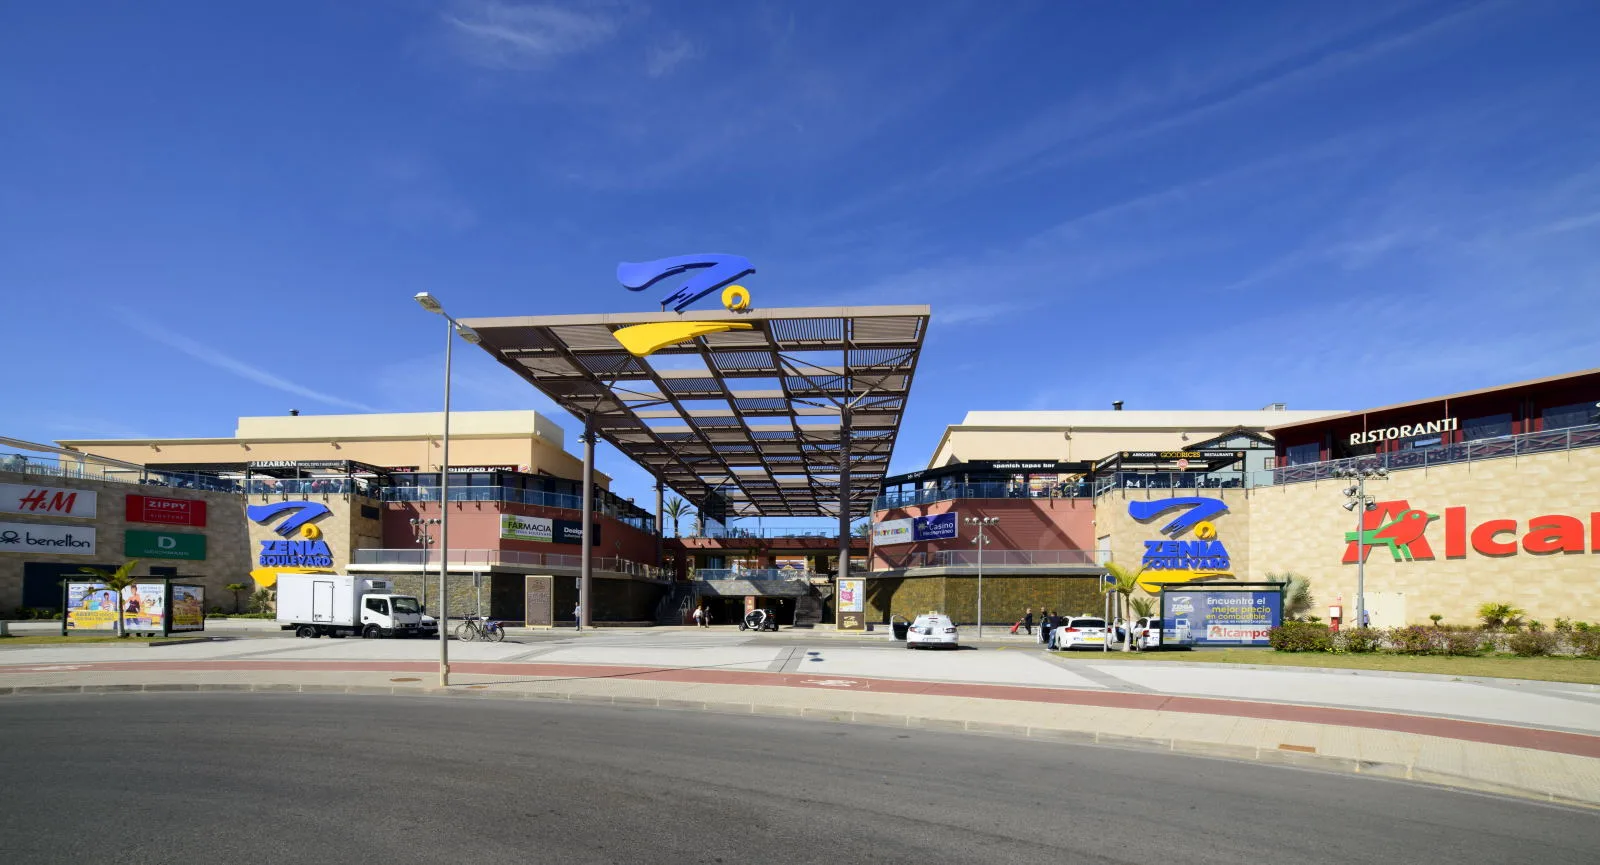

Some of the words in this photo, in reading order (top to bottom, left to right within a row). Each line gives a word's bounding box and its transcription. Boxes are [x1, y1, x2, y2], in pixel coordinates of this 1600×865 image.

[1350, 417, 1457, 446] RISTORANTI
[19, 489, 78, 514] H&M
[149, 501, 186, 510] ZIPPY
[508, 521, 551, 532] FARMACIA
[929, 523, 954, 531] Casino
[1341, 500, 1600, 565] Alca
[26, 531, 91, 548] benetton
[158, 536, 177, 549] D
[260, 540, 333, 557] ZENIA
[1142, 540, 1230, 558] ZENIA
[259, 556, 333, 567] BOULEVARD
[1142, 558, 1231, 570] BOULEVARD
[1207, 597, 1254, 605] Encuentra
[1256, 597, 1266, 605] el
[1212, 606, 1239, 614] mejor
[1209, 626, 1269, 639] Alcampo
